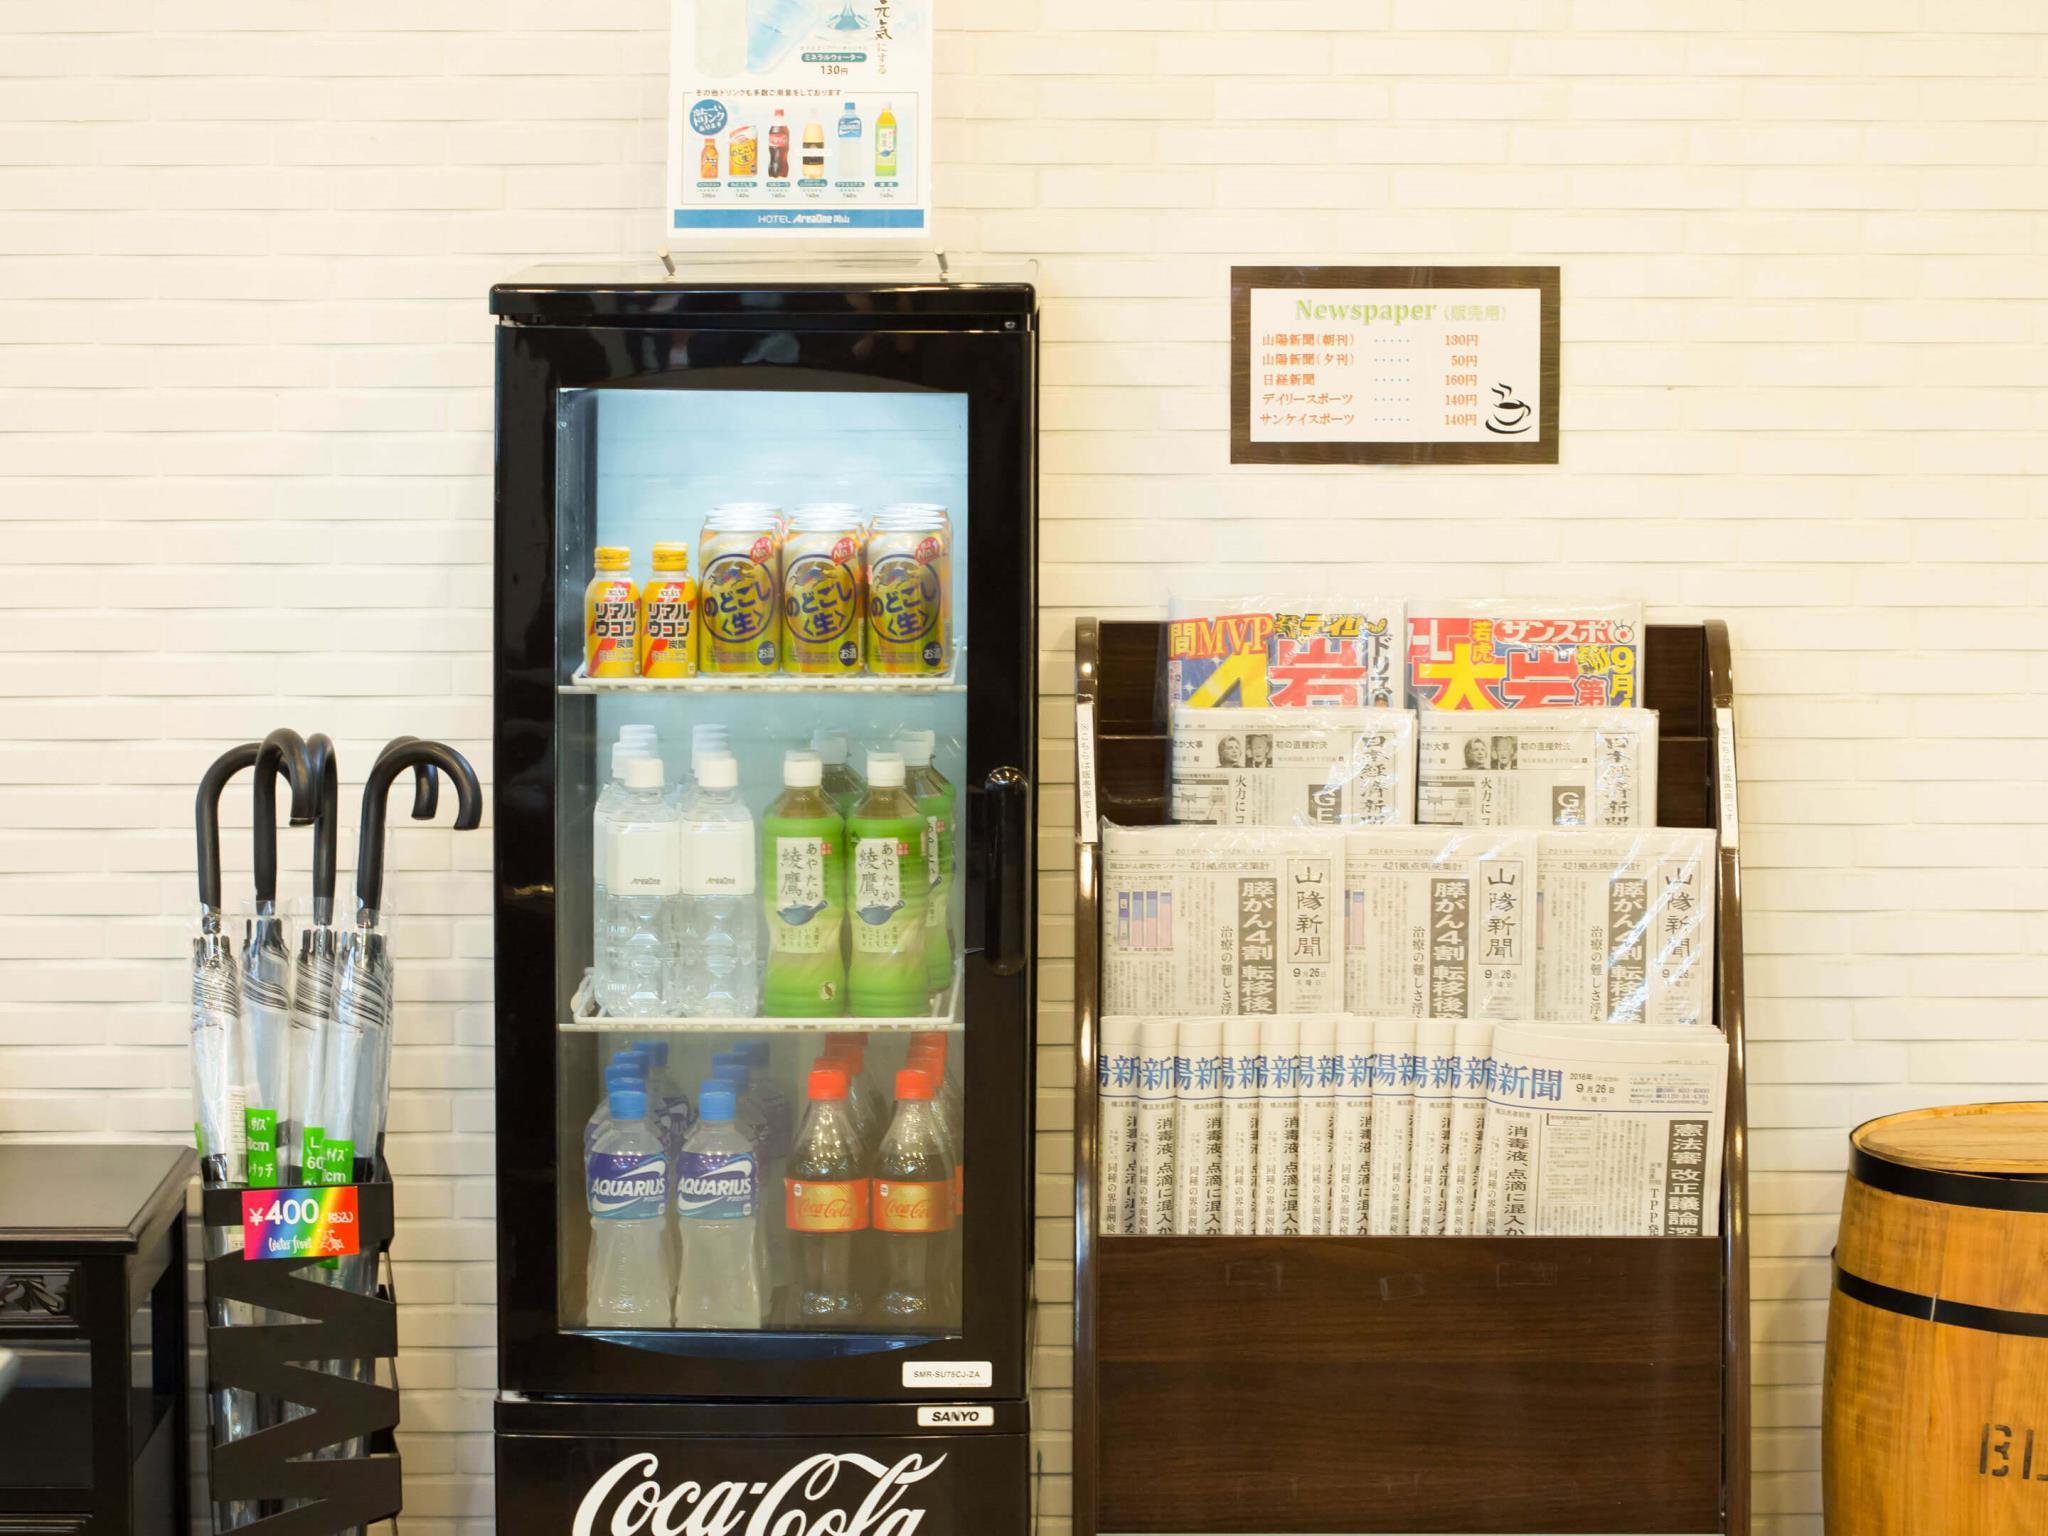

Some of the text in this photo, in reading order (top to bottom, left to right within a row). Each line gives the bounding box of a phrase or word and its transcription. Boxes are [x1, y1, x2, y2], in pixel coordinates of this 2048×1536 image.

[821, 65, 848, 74] 130円
[758, 215, 791, 223] HOTEL
[1295, 299, 1437, 325] Newspaper
[1444, 334, 1478, 346] 130円
[1451, 355, 1478, 367] 50円
[1263, 374, 1477, 386] 日経新聞 160円
[1262, 393, 1478, 406] デイリースポーツ 140円
[1259, 414, 1477, 426] サンケイスポーツ 140円
[595, 603, 636, 619] リアル
[648, 603, 690, 619] リアル
[595, 620, 636, 637] ウコン
[648, 621, 690, 637] ウコン
[1502, 620, 1607, 643] サンスポ
[781, 848, 803, 897] 綾鷹
[806, 843, 818, 901] あやたか
[859, 848, 880, 897] 綾鷹
[881, 843, 895, 901] あやたか
[1295, 866, 1324, 957] 山陽新聞
[1488, 867, 1517, 958] 山陽新聞
[1412, 926, 1425, 1018] 治療の難しさ浮
[1241, 964, 1275, 1015] 転移後
[1576, 1083, 1616, 1093] 9月26日
[1672, 1124, 1703, 1164] 憲法審
[592, 1177, 665, 1196] AQUARIUS
[677, 1177, 751, 1196] AQUARIUS
[249, 1198, 319, 1226] ¥400
[932, 1411, 980, 1421] SANYO
[572, 1452, 948, 1536] Coca-Cola
